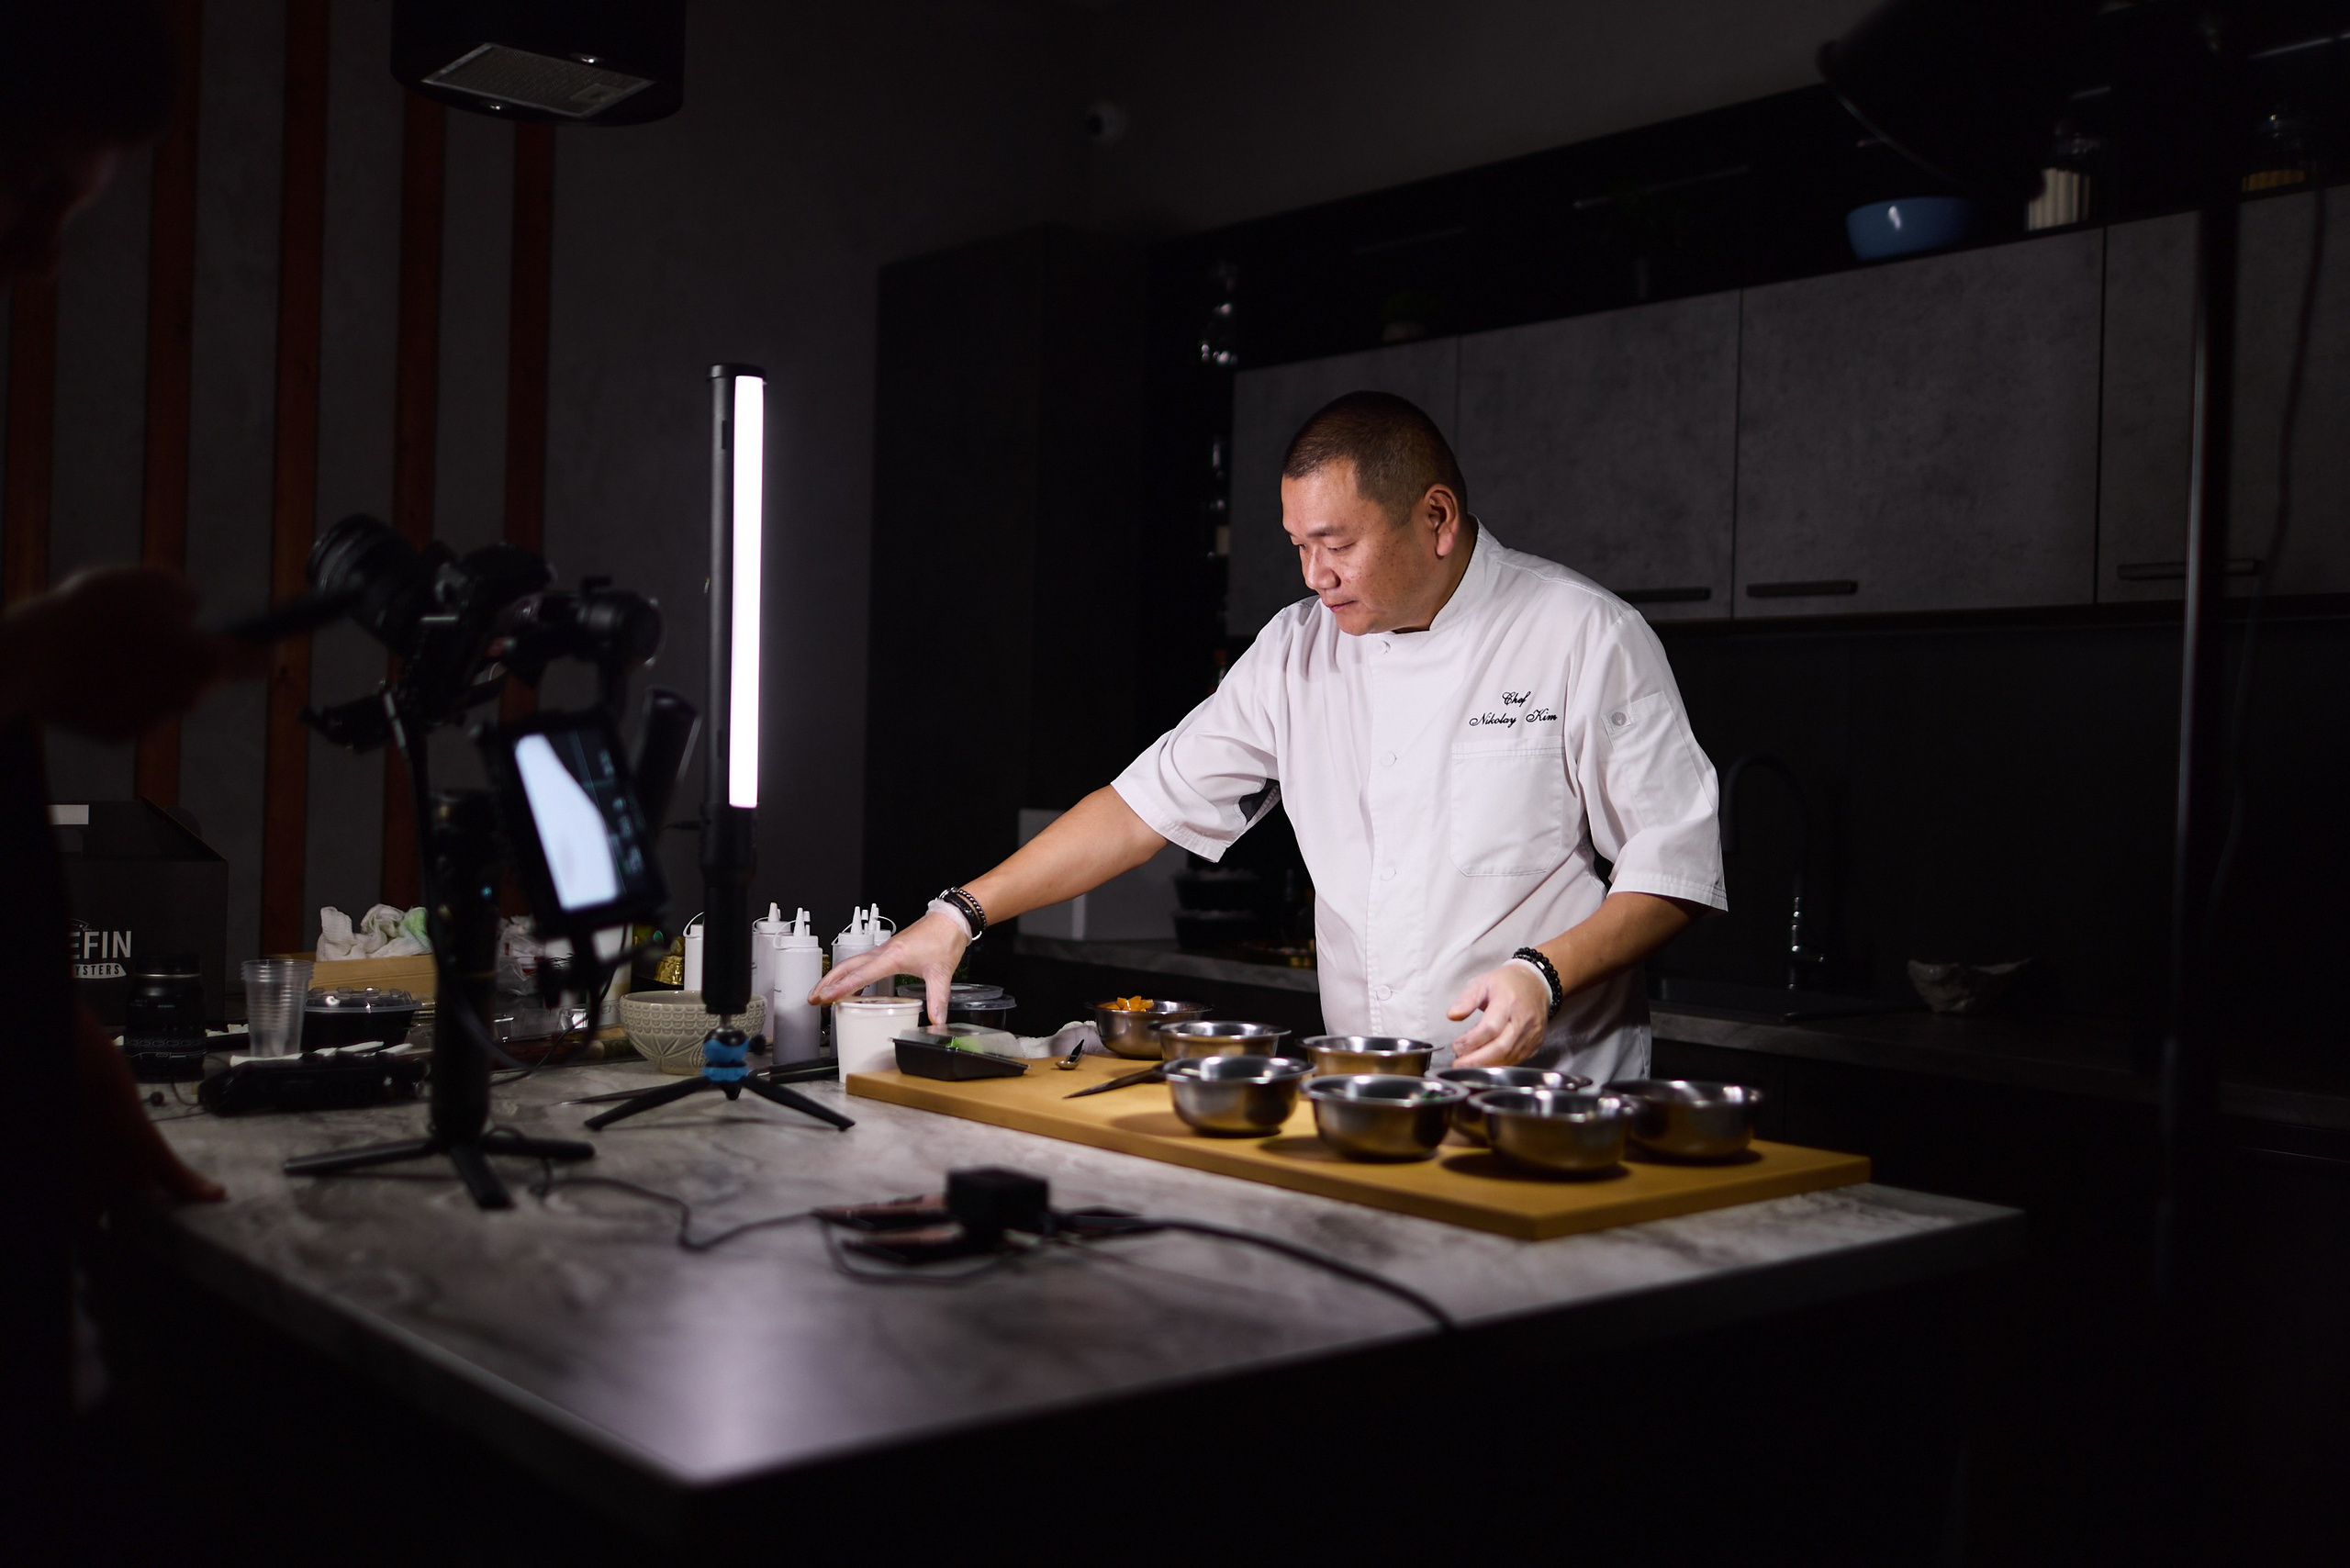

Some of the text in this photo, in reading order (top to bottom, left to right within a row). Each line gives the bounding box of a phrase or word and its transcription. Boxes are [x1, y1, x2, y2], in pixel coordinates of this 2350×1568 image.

[1502, 691, 1531, 707] Chef
[1469, 708, 1558, 728] Nikolay Kim
